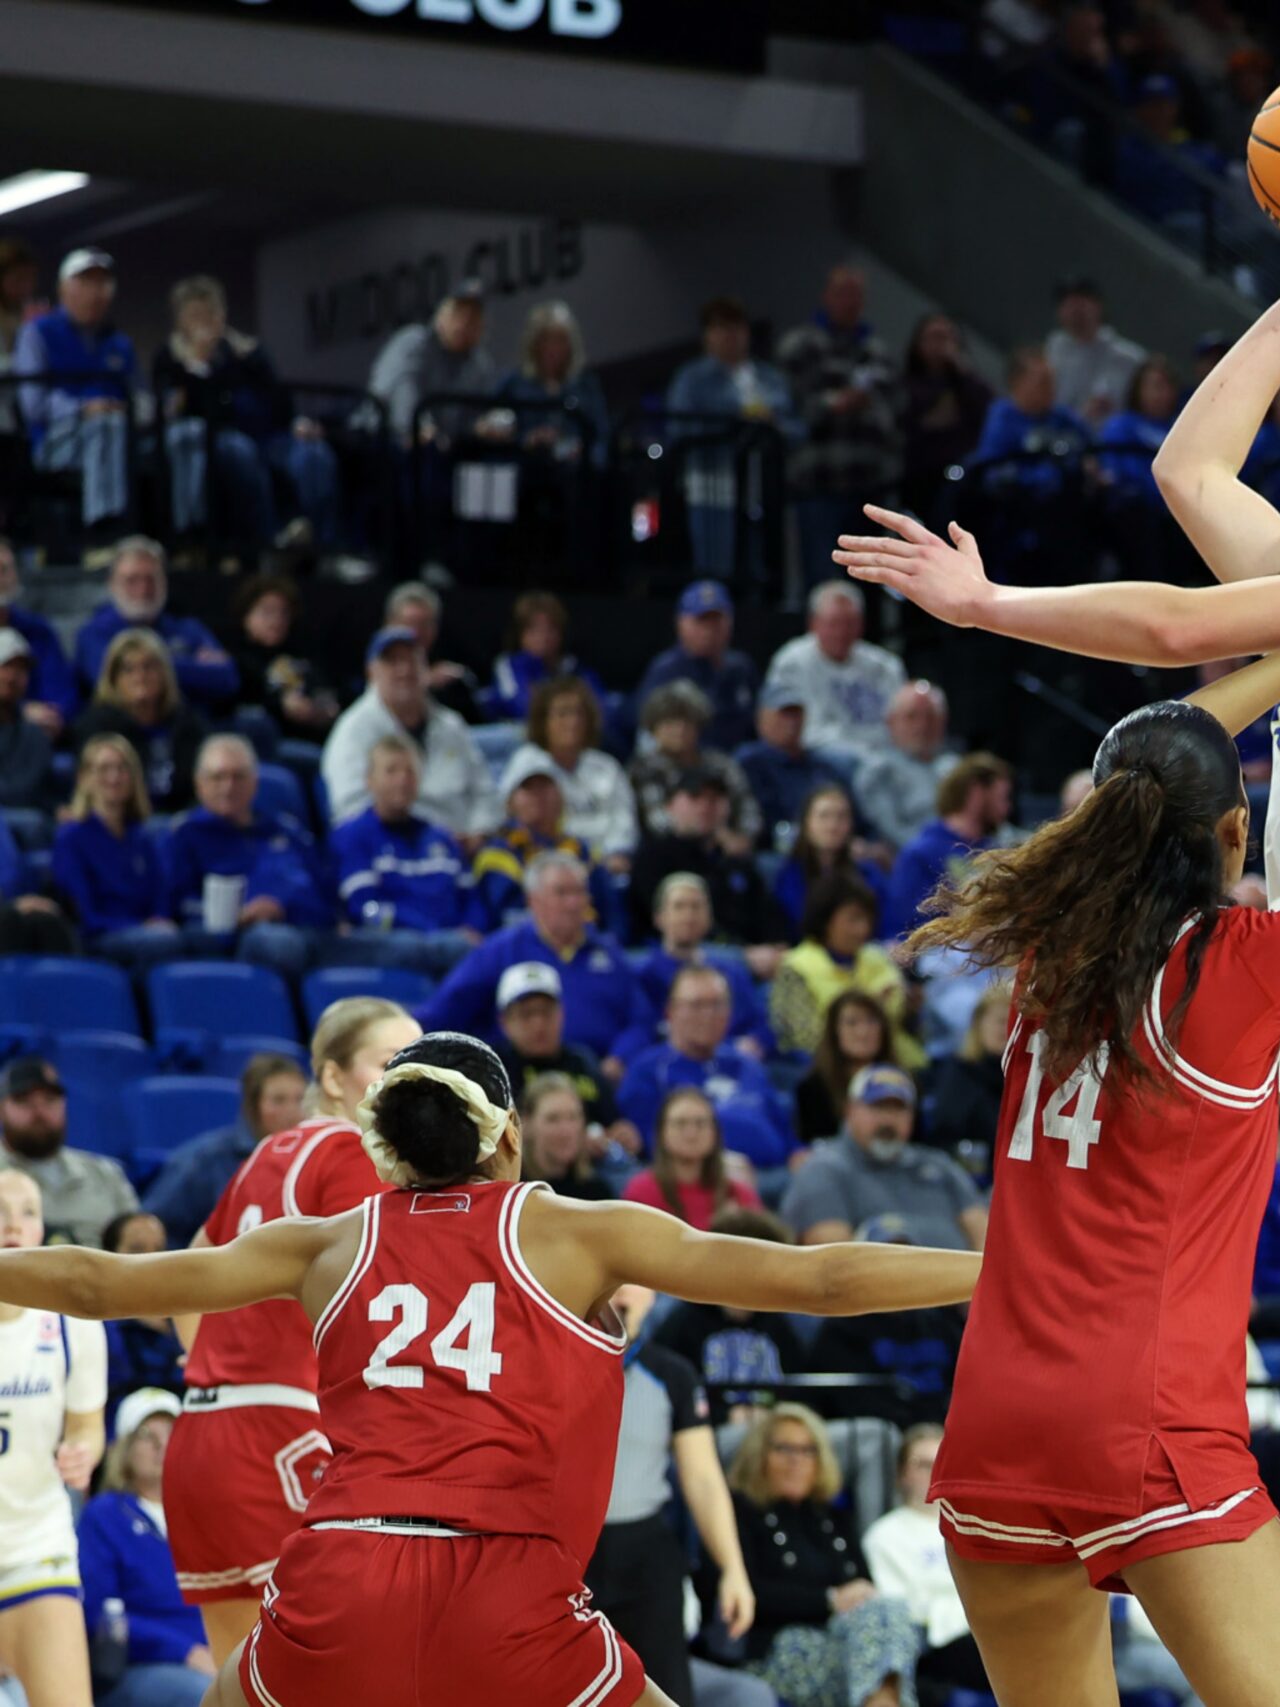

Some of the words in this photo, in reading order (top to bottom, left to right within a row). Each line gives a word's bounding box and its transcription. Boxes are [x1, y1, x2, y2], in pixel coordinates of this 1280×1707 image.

[348, 0, 622, 38] LUB
[463, 219, 584, 297] CLUB
[1007, 1029, 1110, 1170] 14
[363, 1282, 502, 1392] 24
